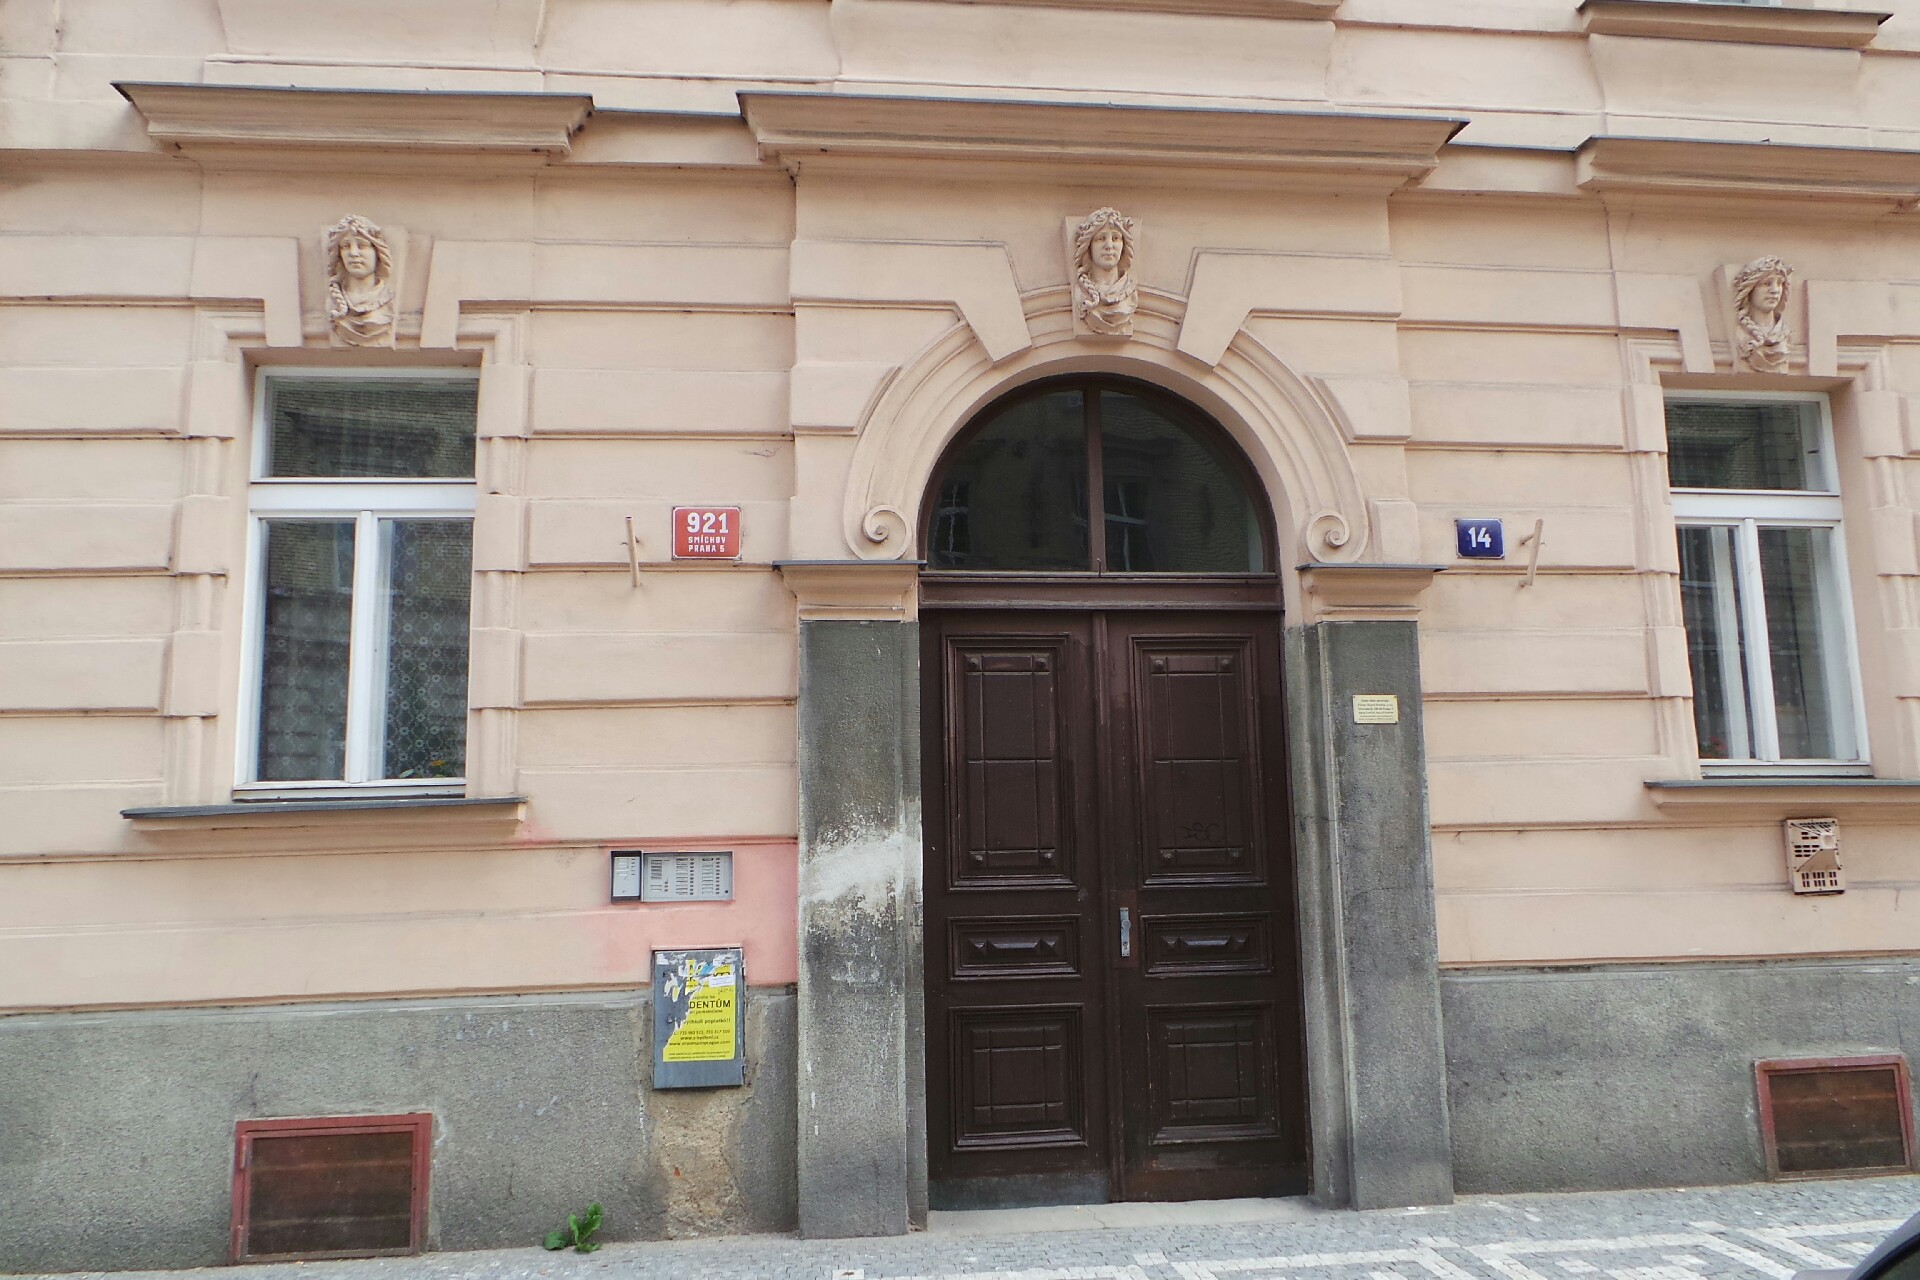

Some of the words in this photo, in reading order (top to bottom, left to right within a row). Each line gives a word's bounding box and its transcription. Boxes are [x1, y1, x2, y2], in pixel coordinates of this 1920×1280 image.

[686, 512, 728, 533] 921
[688, 534, 726, 544] SMÍCHOV
[1468, 527, 1492, 548] 14
[688, 544, 716, 552] PRAHA
[720, 544, 724, 552] 5
